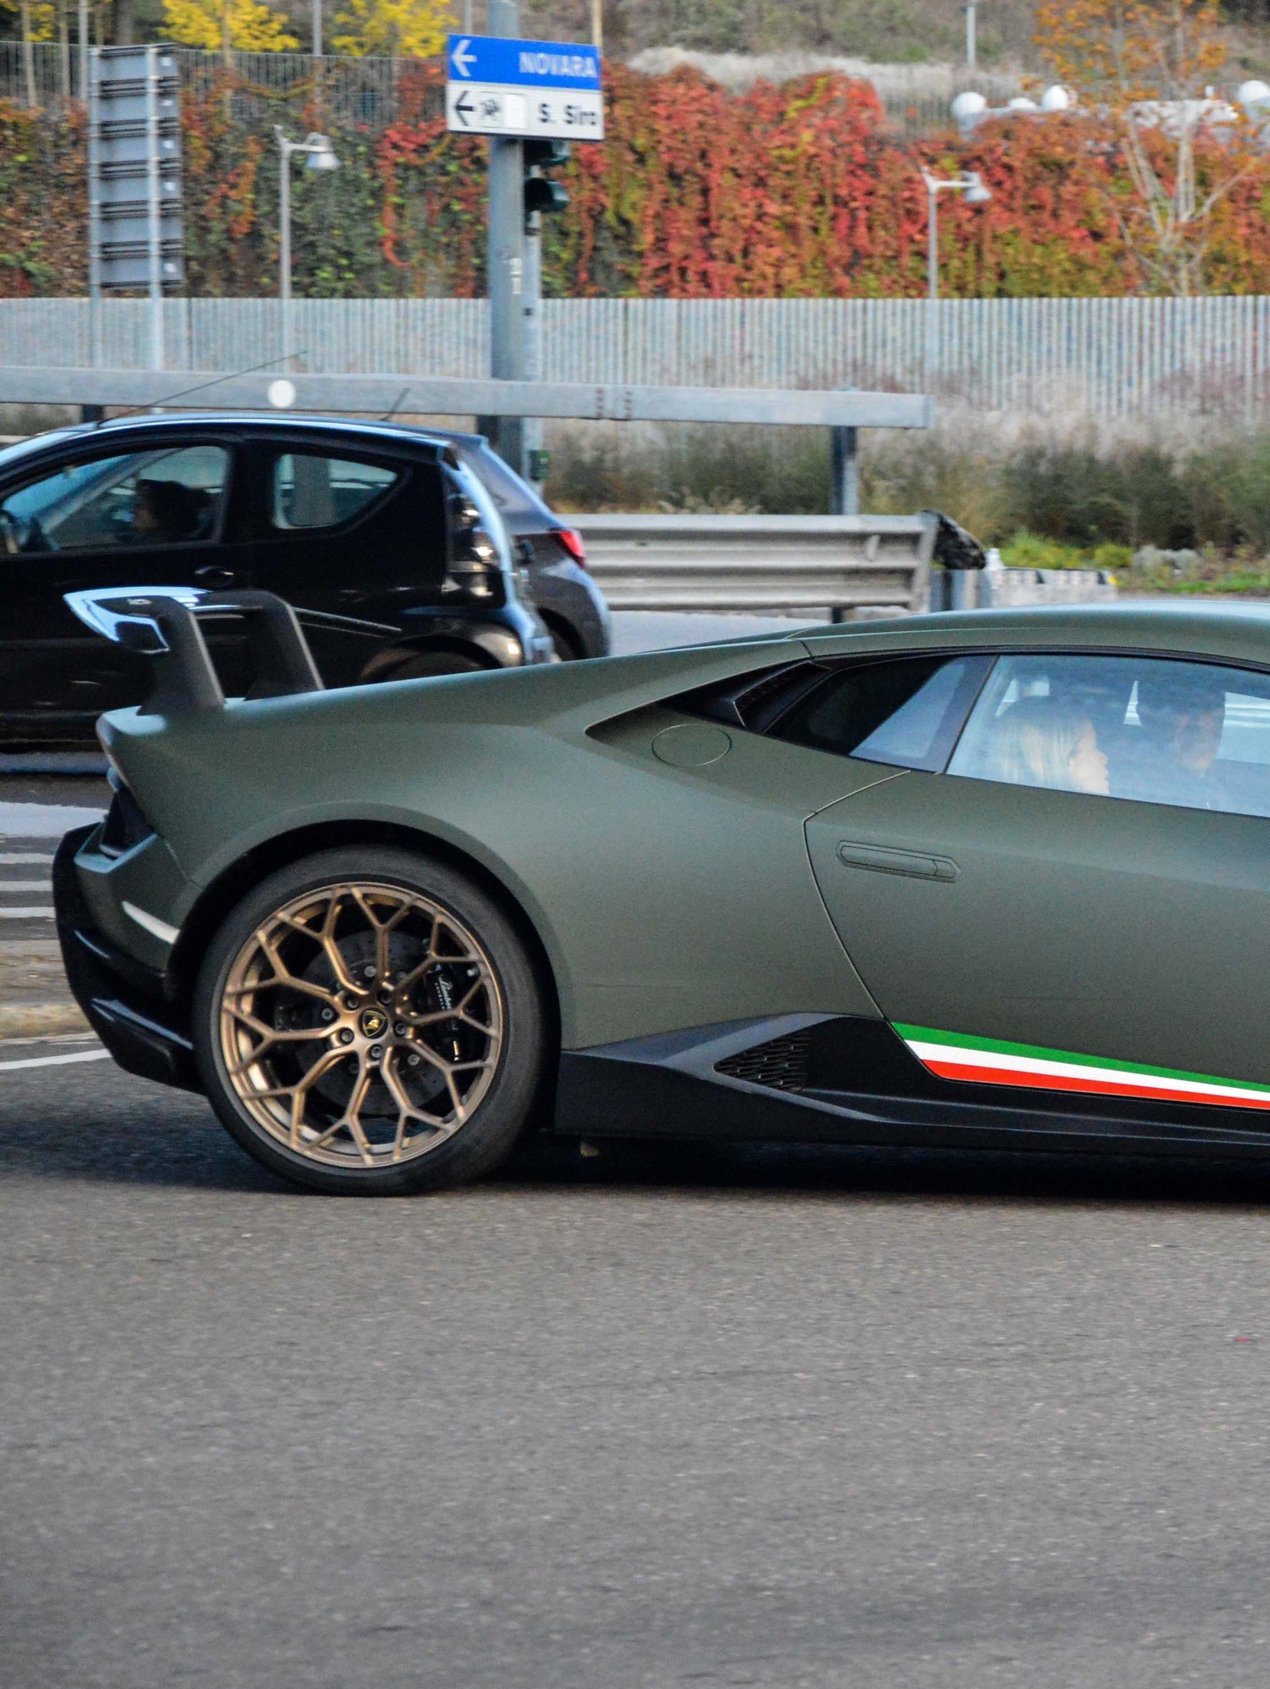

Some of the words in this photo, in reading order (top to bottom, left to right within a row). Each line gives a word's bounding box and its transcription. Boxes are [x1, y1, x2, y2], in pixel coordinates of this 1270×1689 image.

[518, 51, 598, 78] NOVARA
[538, 102, 556, 124] S.
[563, 103, 598, 126] Siro
